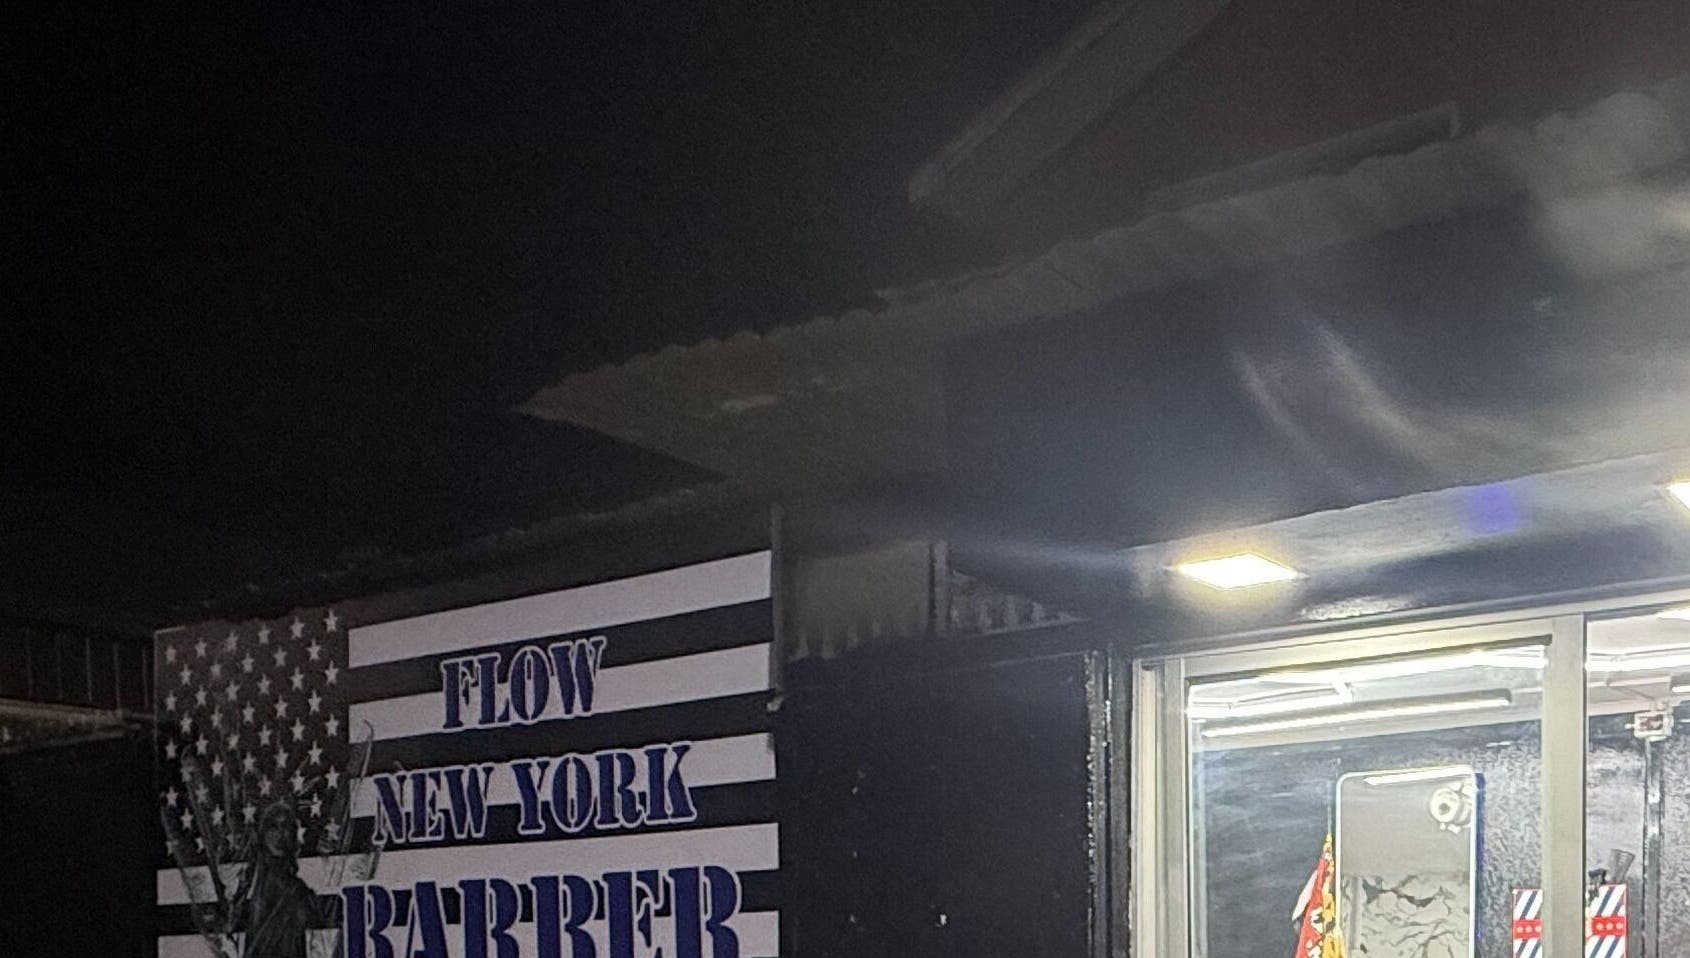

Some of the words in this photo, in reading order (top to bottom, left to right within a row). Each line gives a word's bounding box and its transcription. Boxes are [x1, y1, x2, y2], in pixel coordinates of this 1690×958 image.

[441, 636, 606, 733] FLOW
[372, 763, 495, 845] NEW
[511, 741, 697, 833] YORK
